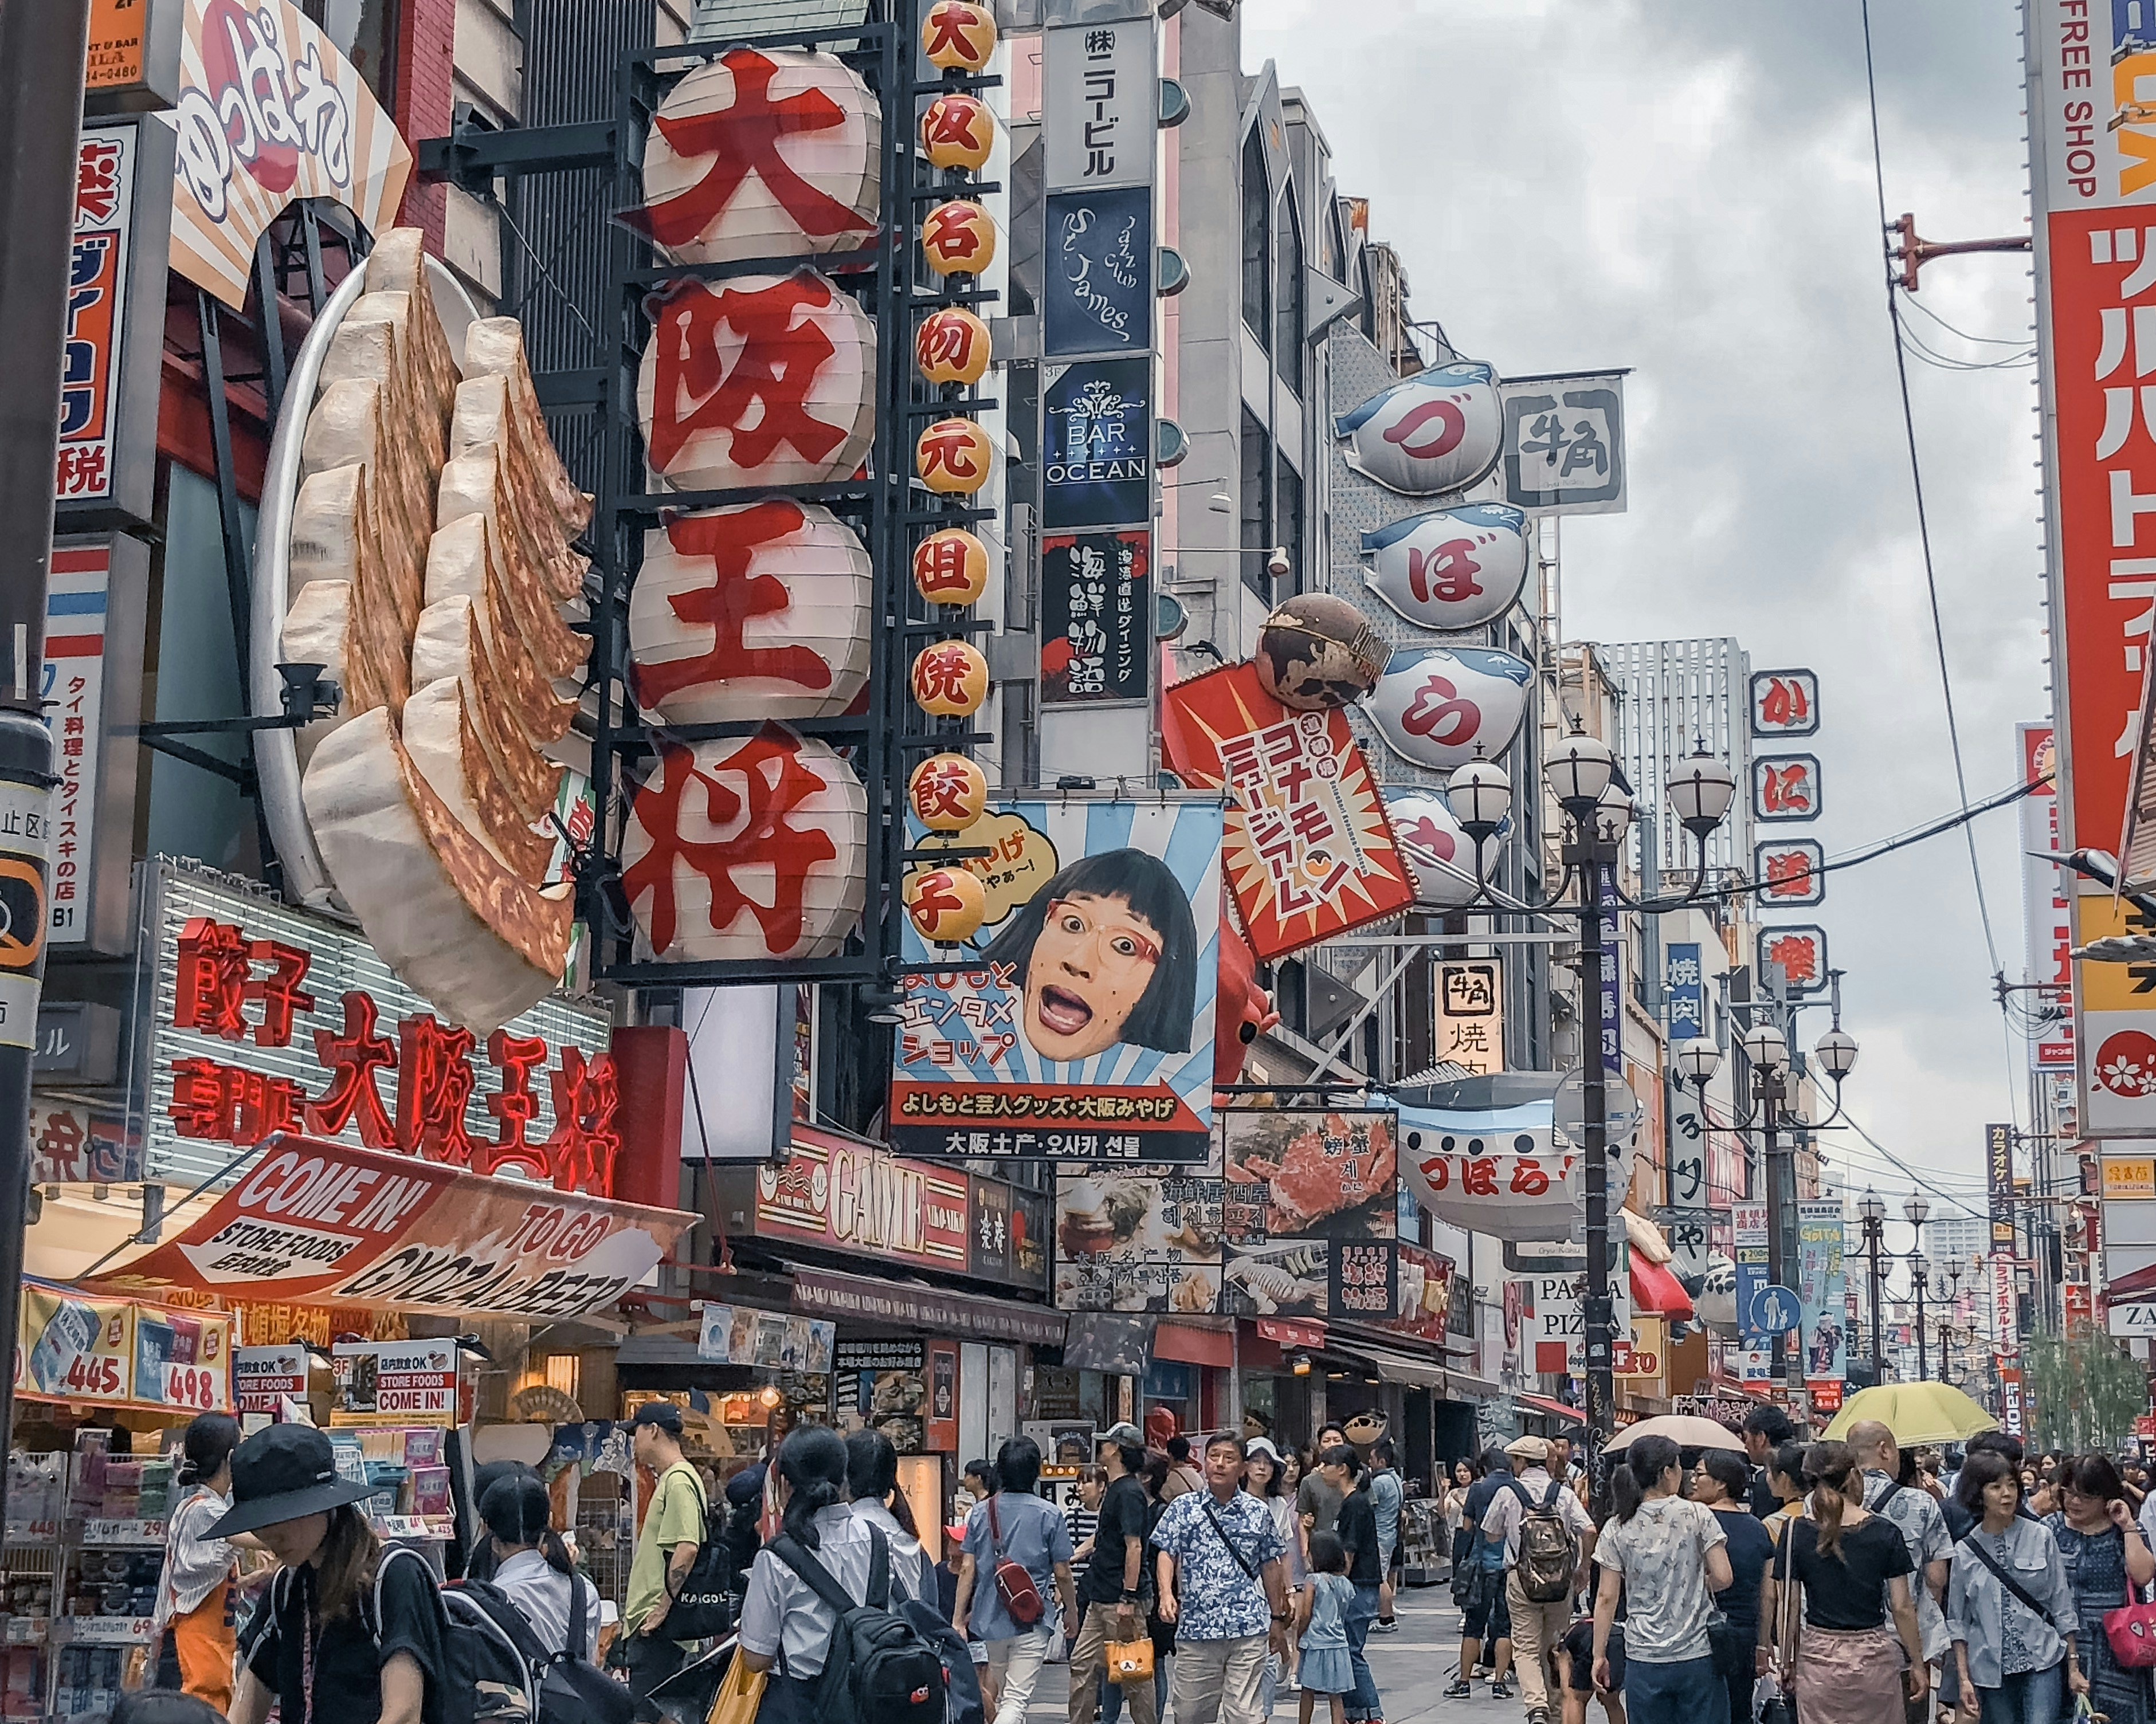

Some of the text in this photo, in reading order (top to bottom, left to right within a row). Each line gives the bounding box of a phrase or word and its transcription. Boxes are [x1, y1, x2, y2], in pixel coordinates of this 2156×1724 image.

[116, 38, 138, 48] BAR
[2060, 0, 2096, 198] FREE SHOP
[1067, 253, 1130, 341] James
[1045, 365, 1061, 379] 3F
[1068, 422, 1126, 446] BAR
[1520, 414, 1608, 477] 牛角
[1046, 459, 1146, 483] OCEAN
[614, 49, 878, 956] 大阪王将
[54, 676, 86, 901] タイ料理とタイスキの店
[1220, 737, 1315, 914] ミュージアム
[53, 907, 73, 928] B1
[173, 917, 314, 1047] 餃子
[1450, 976, 1489, 1005] 牛角
[1668, 958, 1700, 1025] 焼肉
[903, 996, 1018, 1028] エンタメ
[901, 1033, 1018, 1067] ショップ
[304, 990, 621, 1199] 大阪王将
[902, 1093, 1175, 1120] よしもと芸人グッズ・大阪みやげ
[1104, 1135, 1141, 1159] 선물
[1992, 1127, 2008, 1181] カラオケ
[238, 1152, 432, 1234] COME IN!
[831, 1148, 926, 1256] GAME
[213, 1222, 355, 1262] STORE FOODS
[508, 1202, 613, 1260] TO GO
[1540, 1279, 1625, 1300] PAA
[1543, 1314, 1624, 1335] PIZ
[67, 1354, 120, 1394] 445
[169, 1365, 213, 1409] 498
[261, 1378, 294, 1391] FOODS
[381, 1374, 444, 1388] STORE FOODS
[379, 1391, 445, 1411] COME IN!
[28, 1521, 55, 1535] 448
